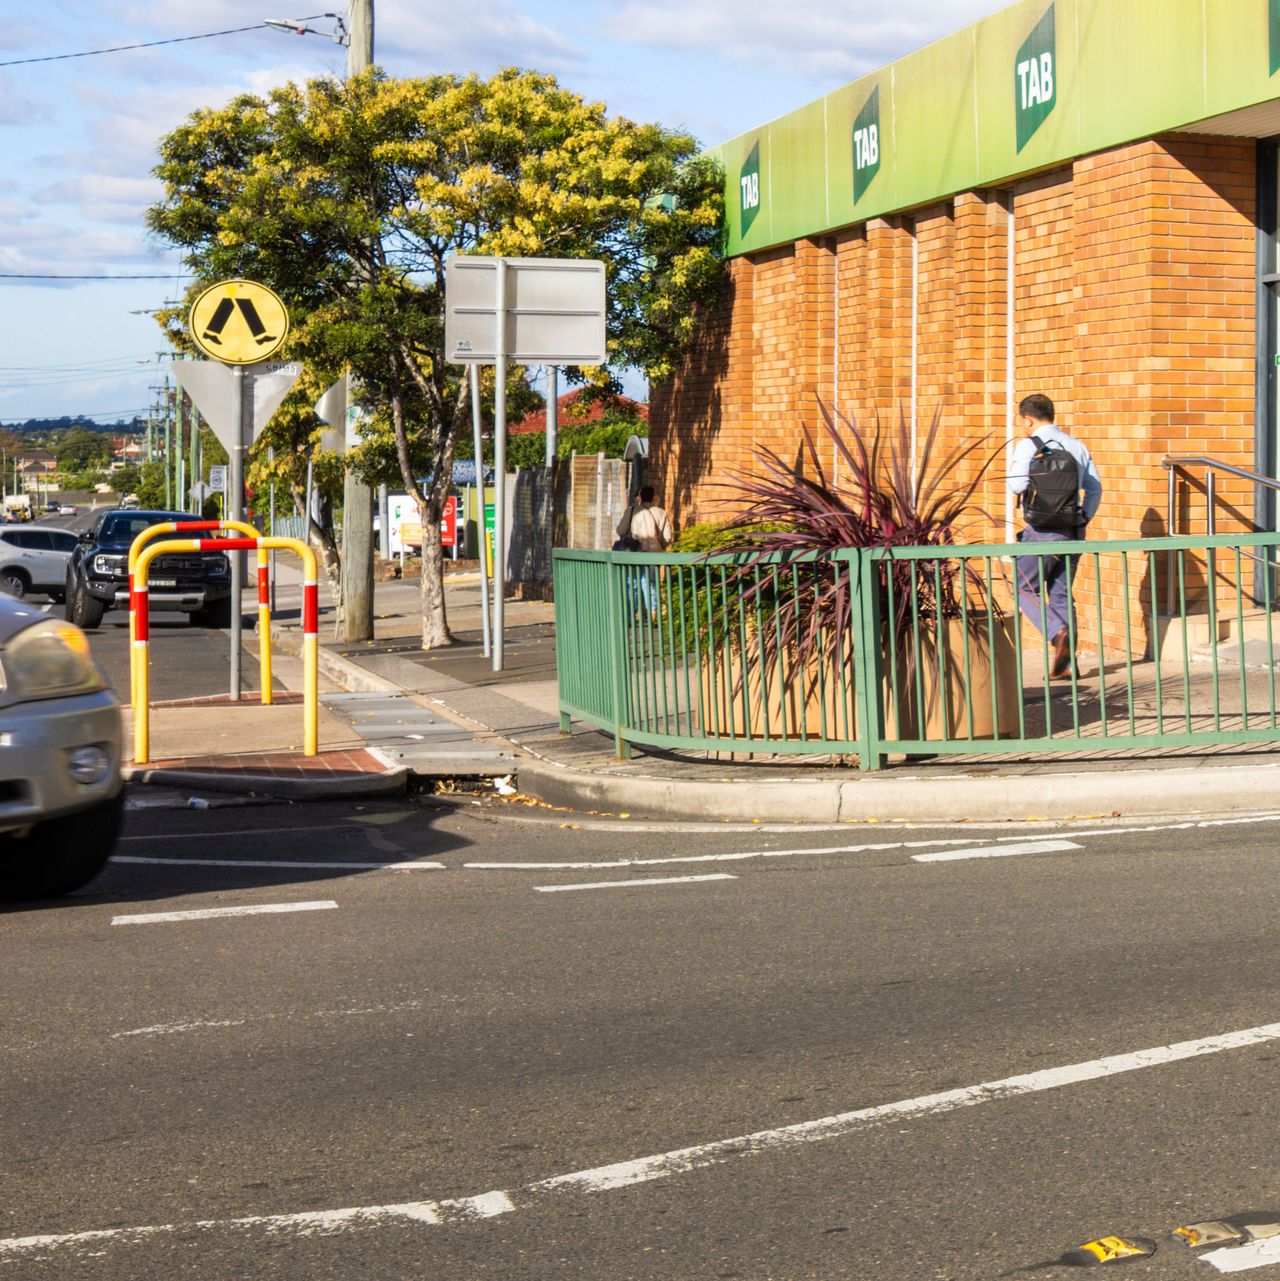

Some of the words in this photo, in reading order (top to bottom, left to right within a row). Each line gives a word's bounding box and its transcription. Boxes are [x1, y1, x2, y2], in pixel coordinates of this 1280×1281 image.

[1017, 52, 1054, 111] TAB
[854, 124, 879, 171] TAB
[740, 172, 759, 211] TAB
